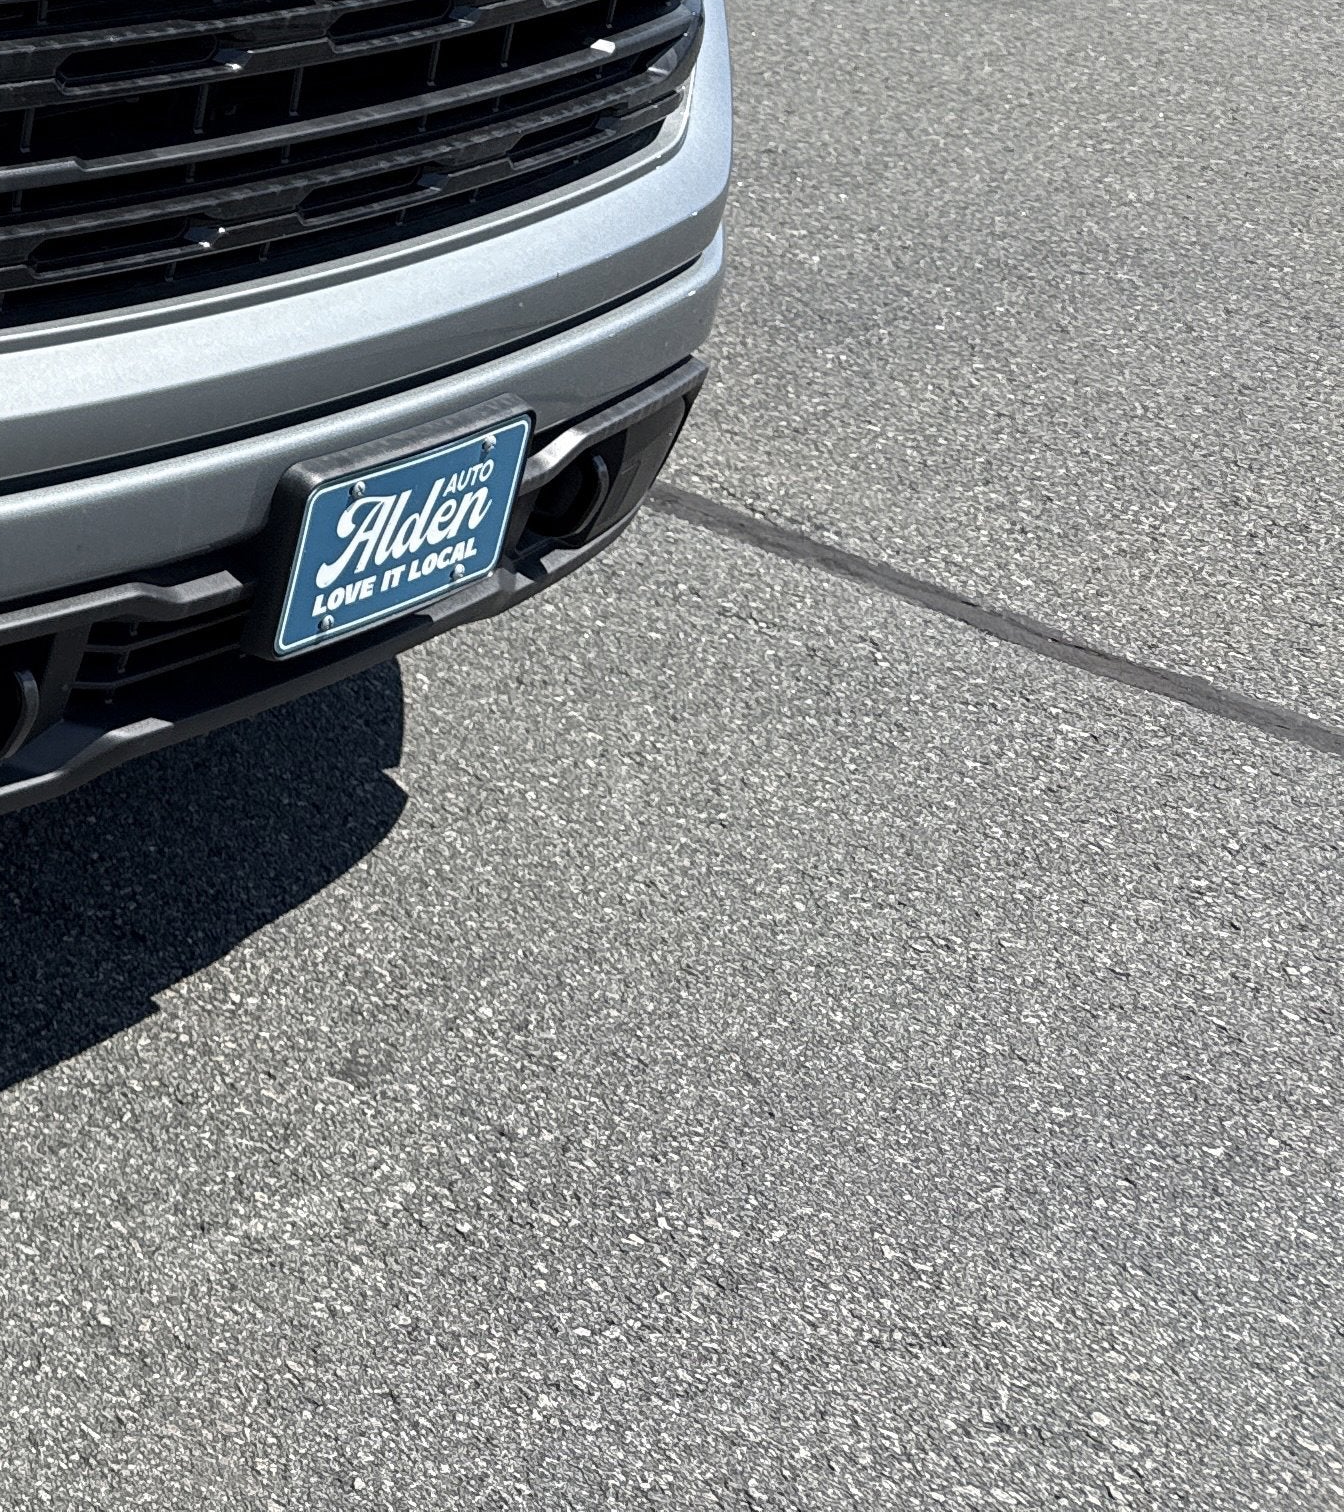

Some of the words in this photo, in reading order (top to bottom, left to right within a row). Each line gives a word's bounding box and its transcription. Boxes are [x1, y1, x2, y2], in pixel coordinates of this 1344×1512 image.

[442, 456, 496, 498] AUTO
[314, 476, 493, 590] Alden
[311, 575, 377, 619] LOVE
[379, 562, 407, 593] IT
[407, 536, 478, 582] LOCAL
